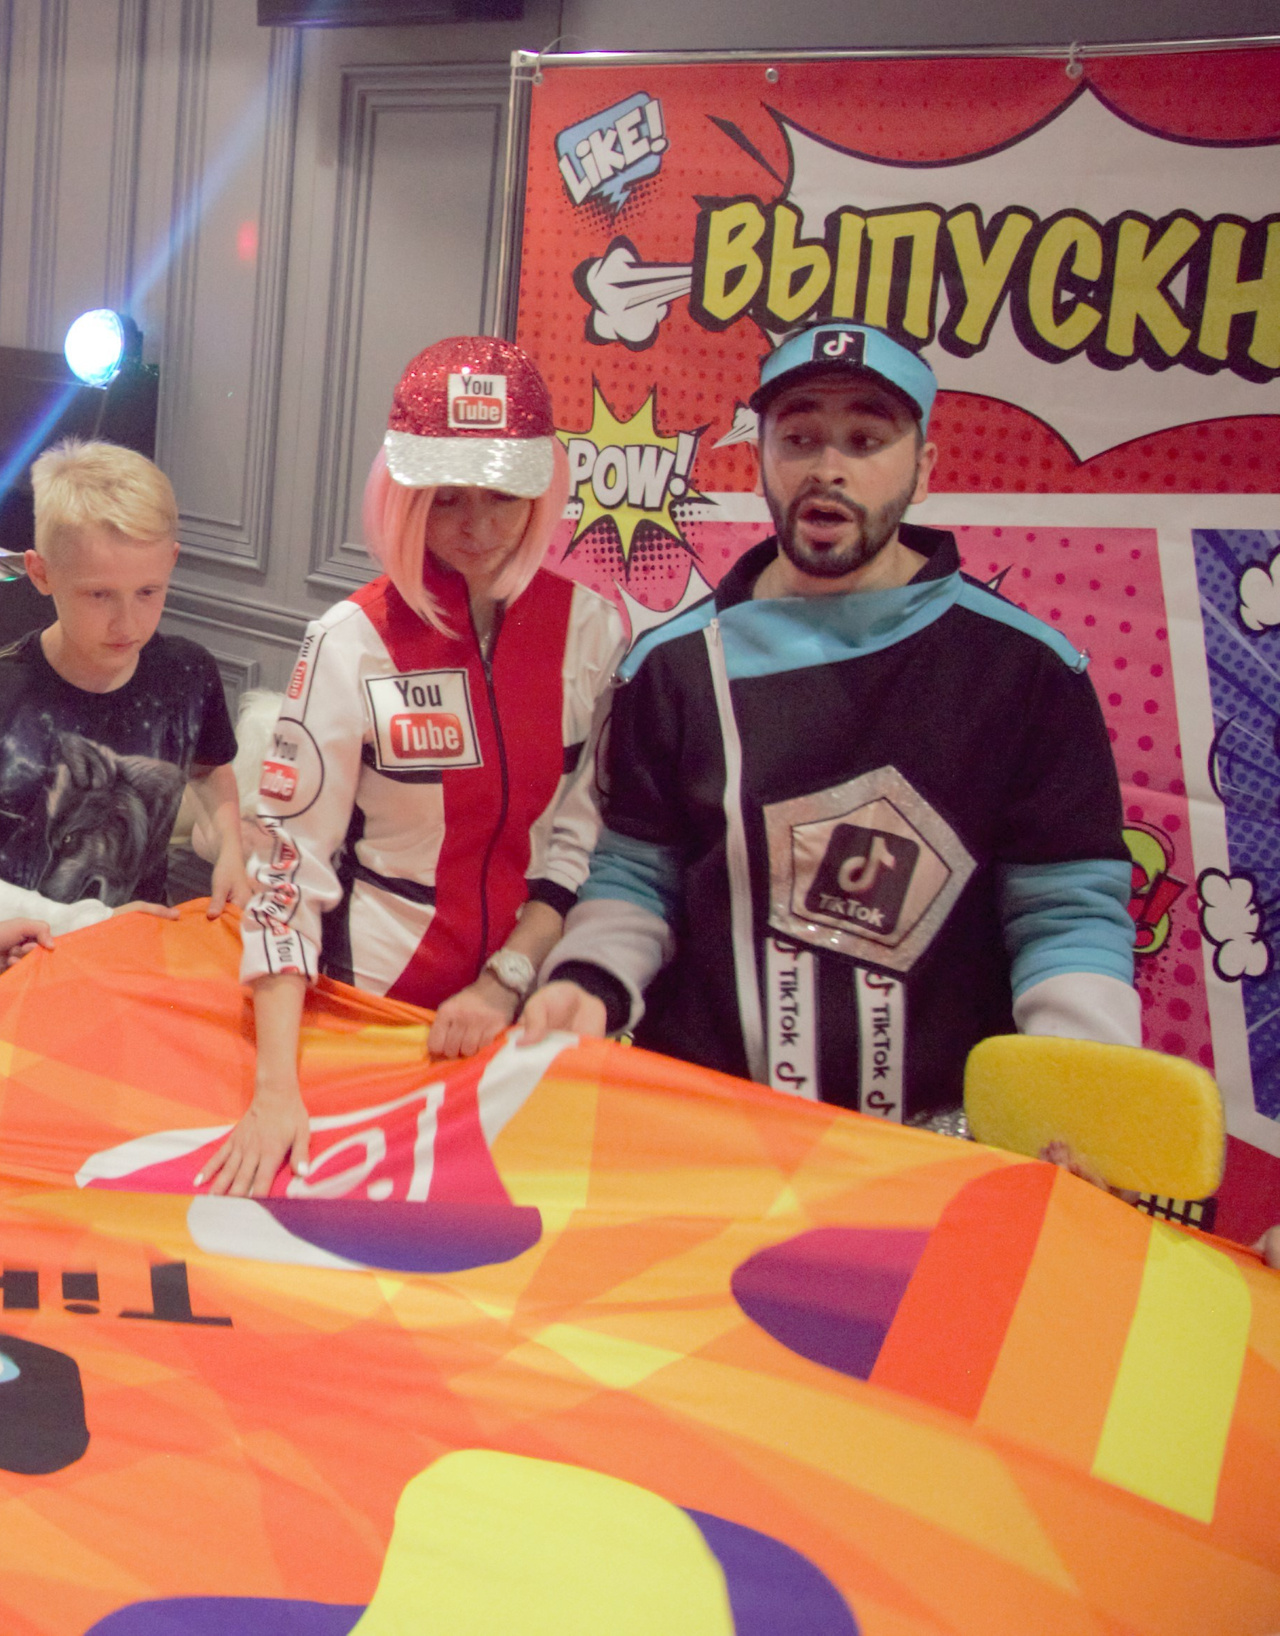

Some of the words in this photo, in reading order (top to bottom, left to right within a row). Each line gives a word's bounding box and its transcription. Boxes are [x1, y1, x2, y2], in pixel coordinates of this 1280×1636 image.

[462, 375, 494, 396] You
[455, 399, 501, 423] Tube
[567, 430, 696, 510] POW!
[393, 681, 442, 709] You
[394, 716, 462, 752] Tube
[276, 936, 295, 963] You
[779, 967, 800, 1046] TikTok
[872, 1003, 892, 1080] TikTok
